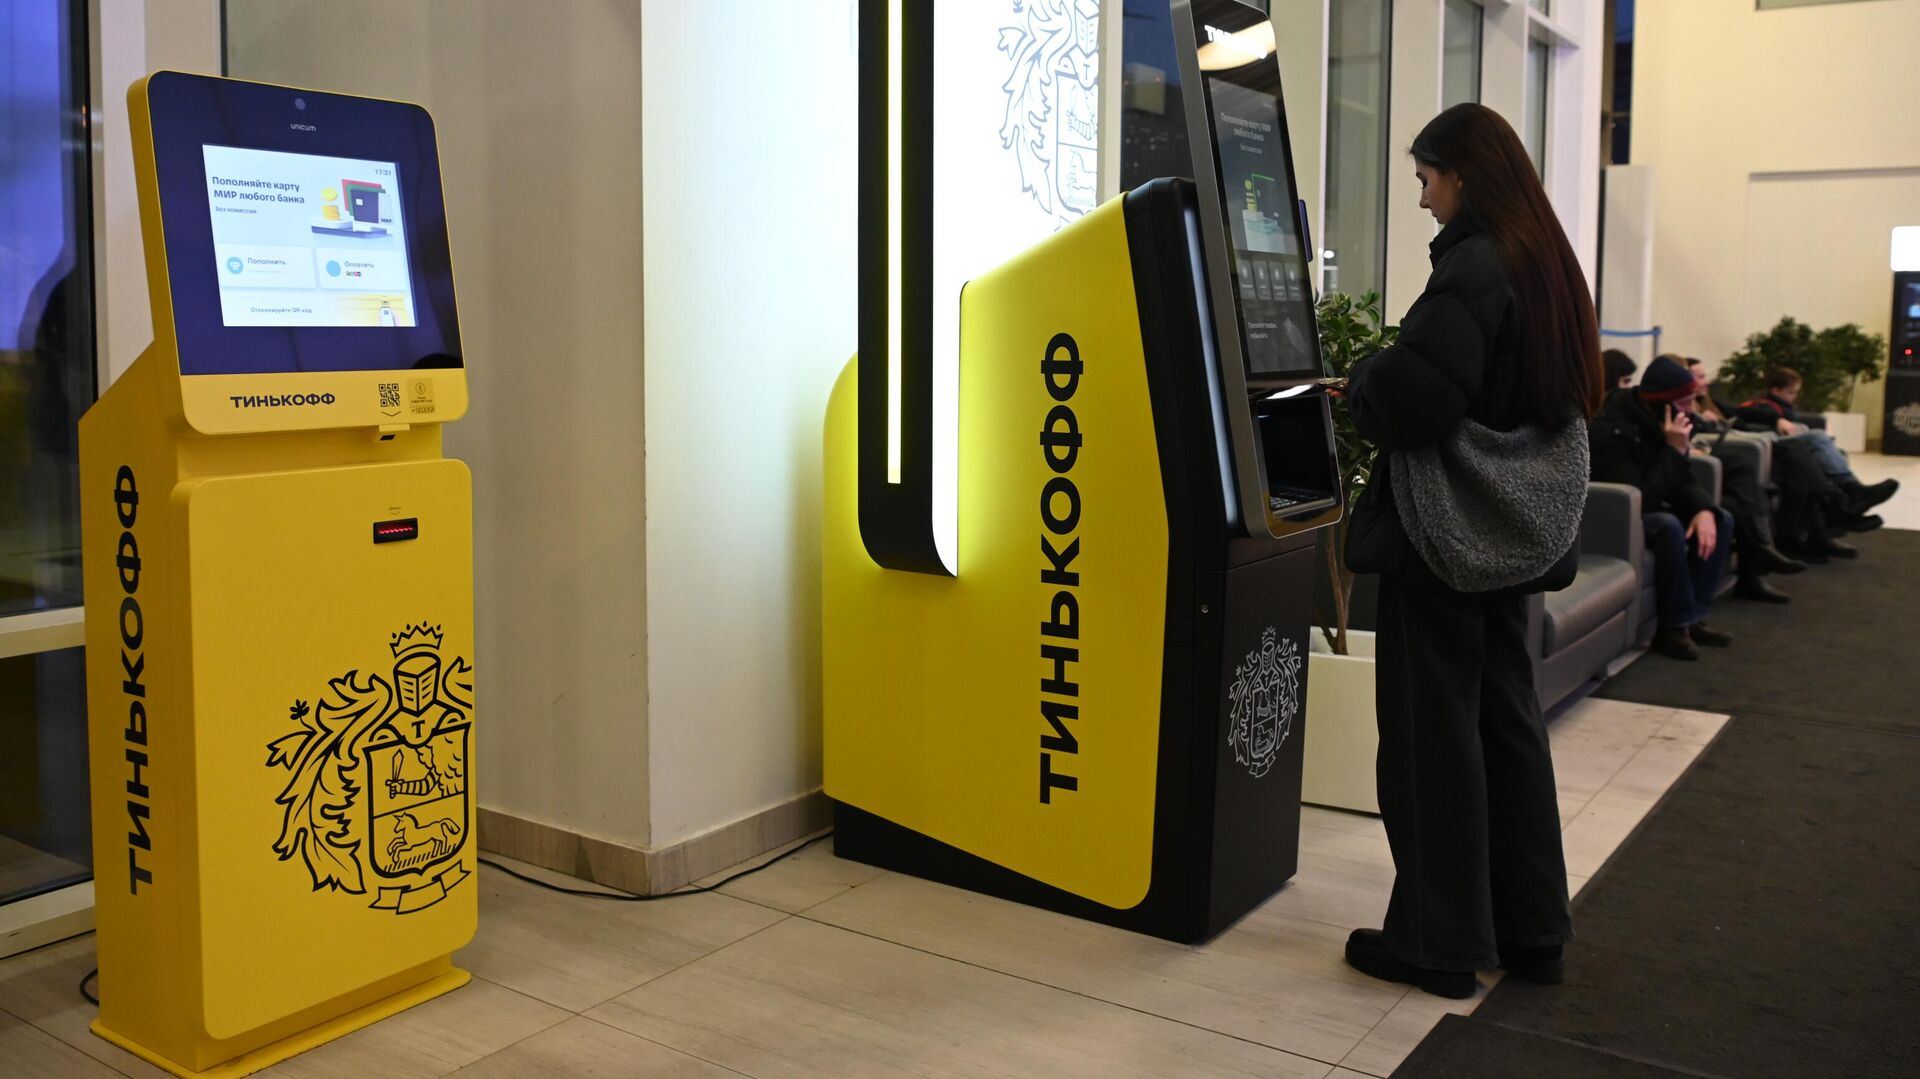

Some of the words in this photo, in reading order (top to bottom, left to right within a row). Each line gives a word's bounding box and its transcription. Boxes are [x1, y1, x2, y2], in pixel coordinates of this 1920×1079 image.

[290, 123, 317, 132] unicum
[212, 176, 272, 189] Пополняйте
[273, 182, 300, 193] карту
[214, 189, 238, 199] МИР
[239, 191, 276, 202] любого
[277, 194, 305, 204] банка
[247, 257, 287, 266] Пополнить
[344, 260, 375, 269] Оплатить
[229, 392, 336, 408] ТИНЬКОФФ
[1039, 332, 1084, 806] ТИНЬКОФФ
[114, 464, 154, 897] ТИНЬКОФФ
